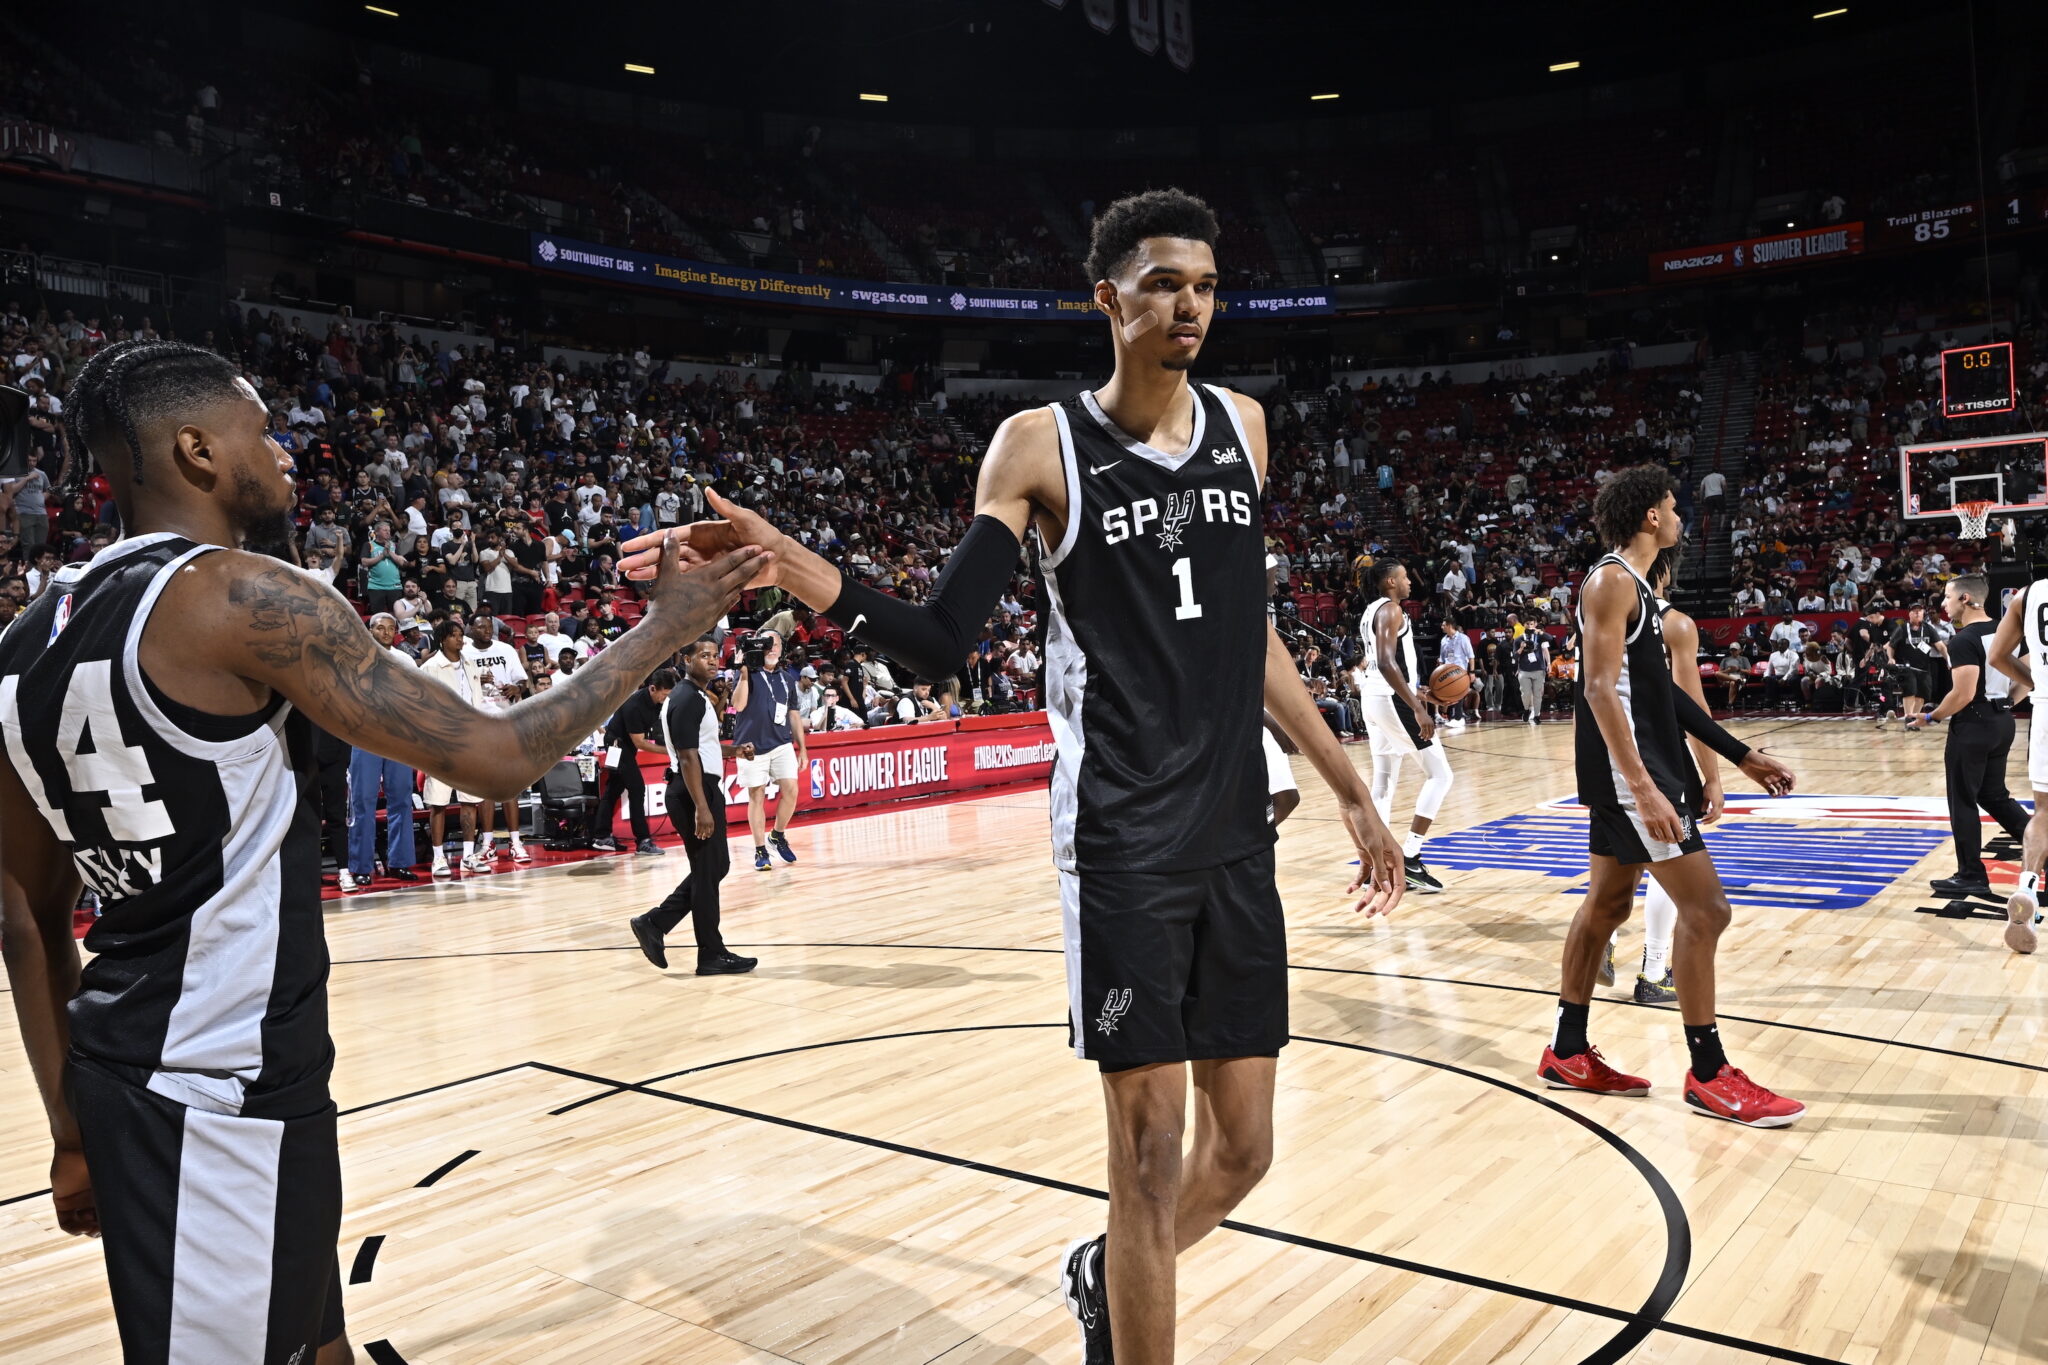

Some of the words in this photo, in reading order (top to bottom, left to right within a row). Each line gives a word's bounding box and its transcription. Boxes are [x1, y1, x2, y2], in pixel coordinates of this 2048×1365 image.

[1887, 213, 1917, 227] Trail
[1921, 205, 1973, 221] Blazers
[2007, 198, 2019, 215] 1
[1914, 219, 1950, 242] 85
[1753, 238, 1802, 264] SUMMER
[1806, 230, 1849, 256] LEAGUE
[560, 248, 614, 269] SOUTHWEST
[616, 258, 635, 272] GAS
[1664, 253, 1724, 271] NBA2K24
[654, 263, 708, 283] Imagine
[711, 272, 757, 292] Energy
[760, 278, 832, 300] Differently
[851, 289, 929, 305] swgas.com
[969, 298, 1019, 310] SOUTHWEST
[1021, 300, 1038, 310] GAS
[1249, 296, 1327, 312] swgas.com
[1963, 351, 1991, 369] 0.0
[1965, 398, 2009, 410] TISSOT
[1102, 489, 1251, 553] SPURS
[1172, 557, 1203, 621] 1
[829, 752, 895, 797] SUMMER
[898, 746, 949, 787] LEAGUE
